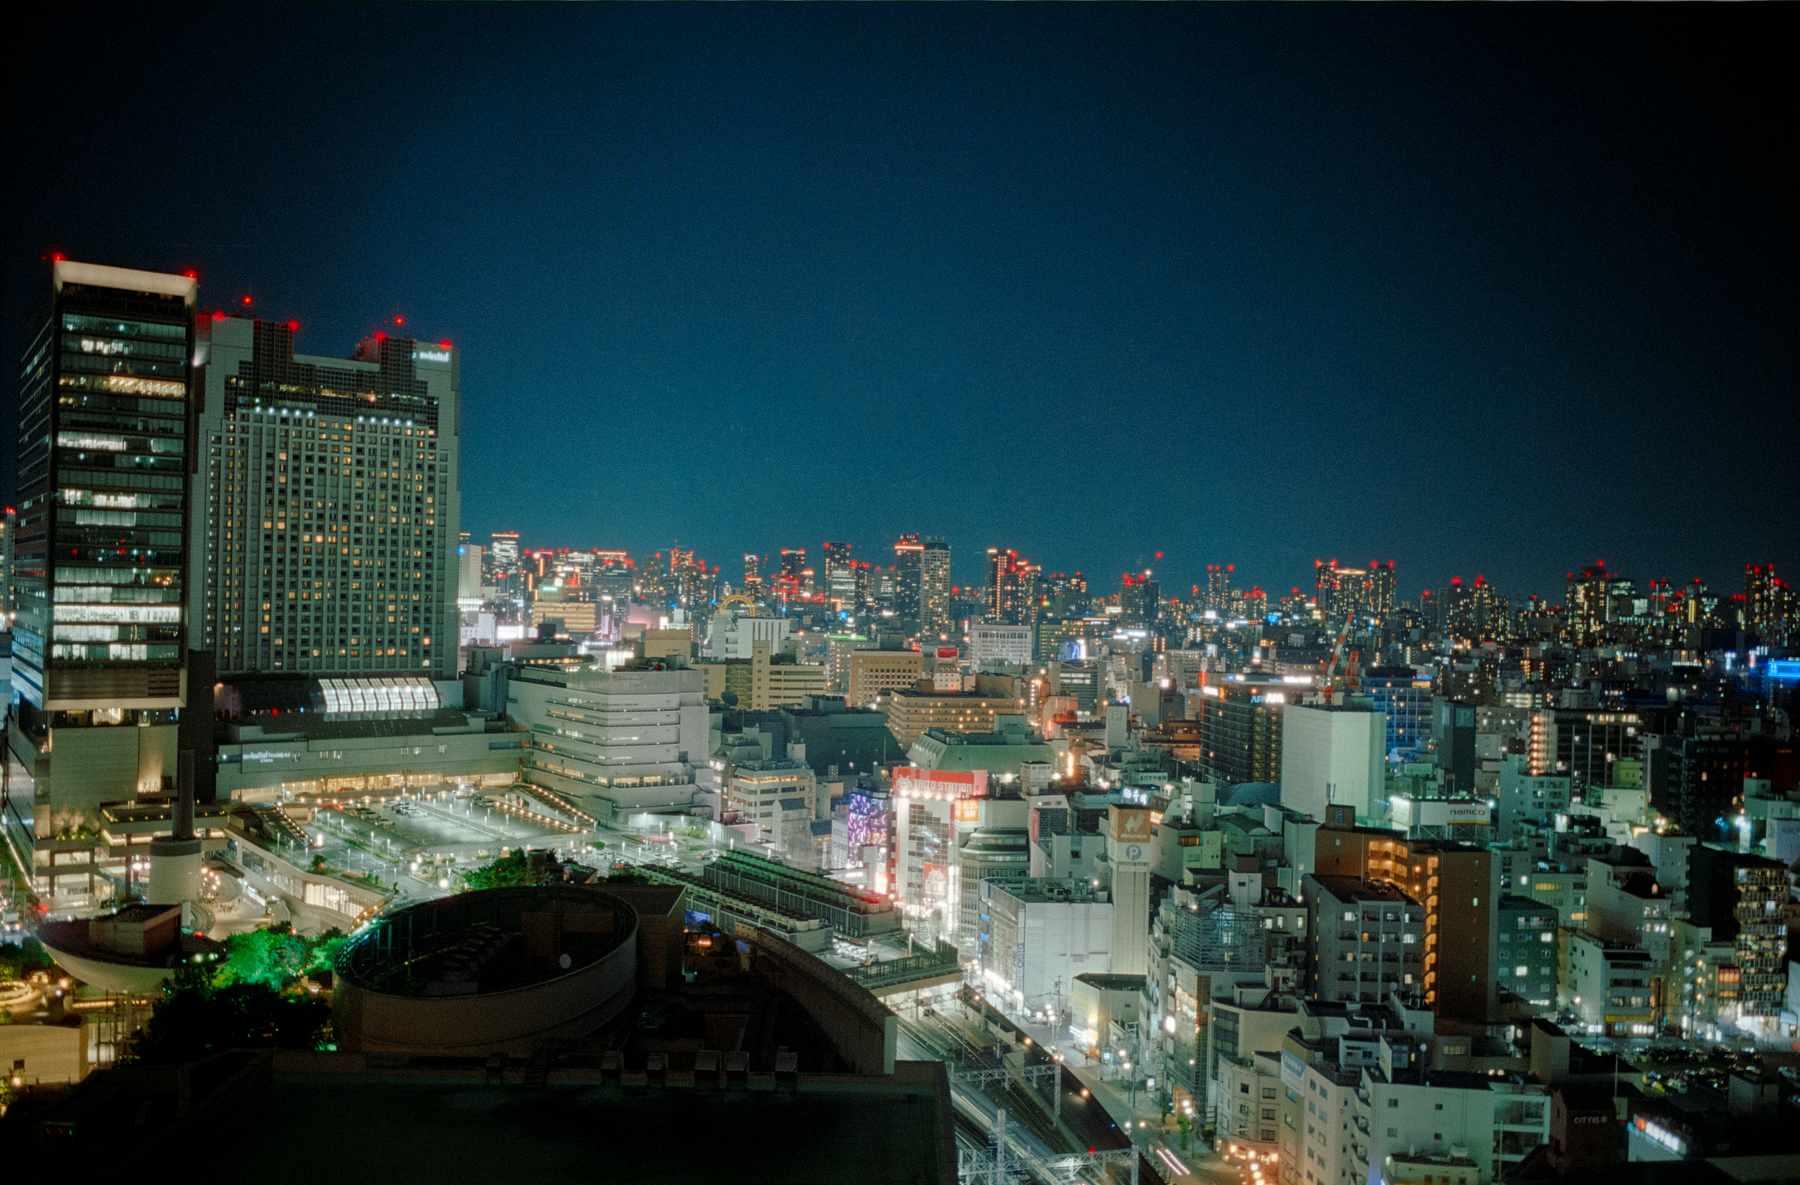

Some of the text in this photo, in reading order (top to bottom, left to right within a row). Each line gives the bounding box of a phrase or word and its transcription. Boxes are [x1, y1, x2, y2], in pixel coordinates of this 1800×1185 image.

[914, 779, 972, 792] TAITO STATION
[1449, 808, 1486, 816] namco
